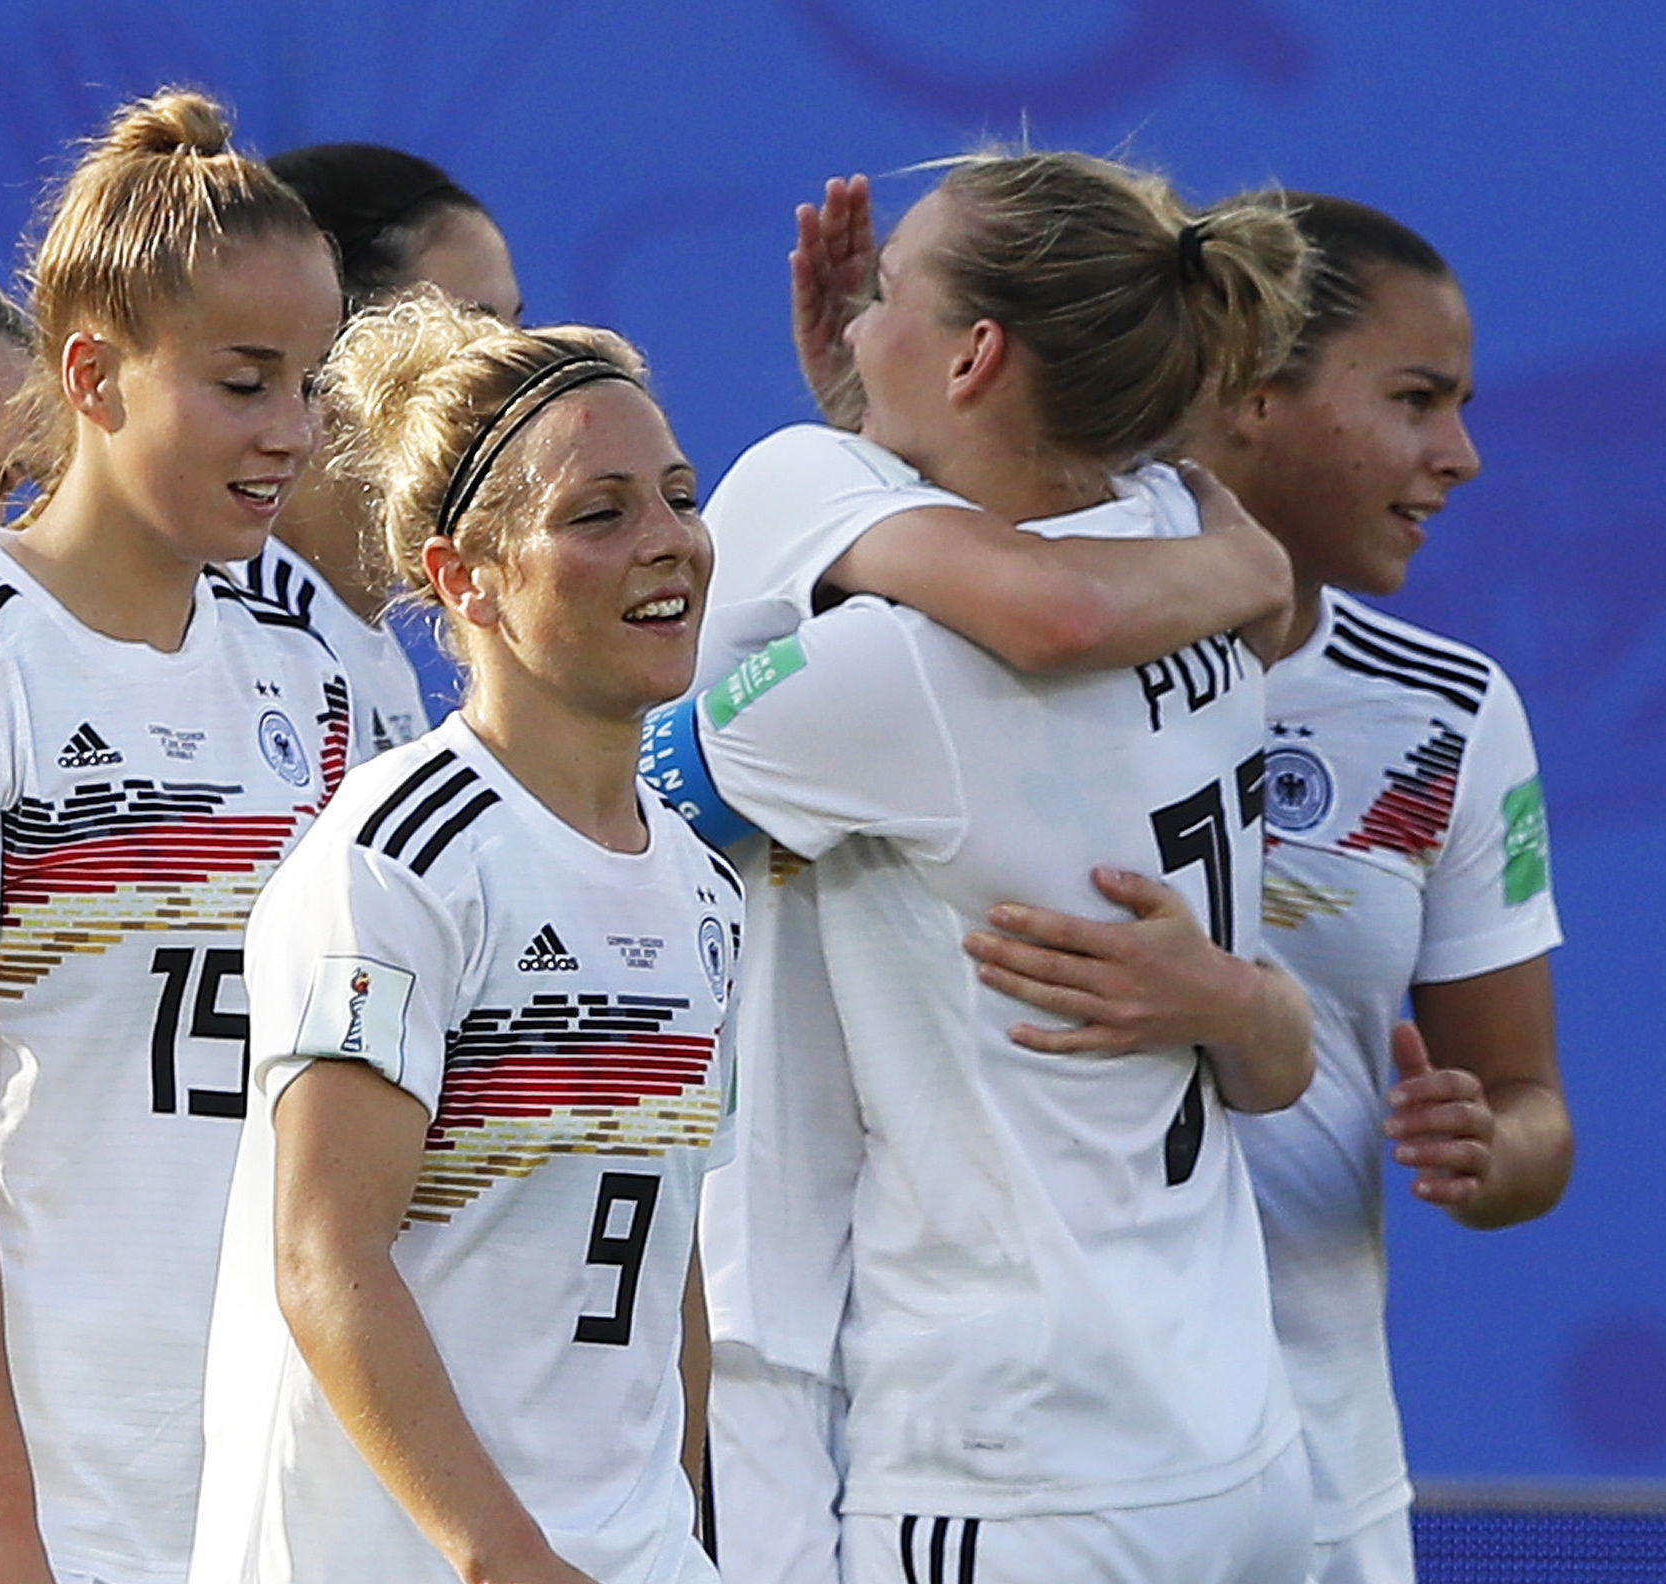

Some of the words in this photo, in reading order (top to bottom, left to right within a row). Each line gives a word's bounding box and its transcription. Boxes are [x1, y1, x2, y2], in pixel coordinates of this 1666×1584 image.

[58, 749, 124, 768] adidas
[517, 955, 579, 972] adidas
[149, 947, 249, 1118] 15
[573, 1172, 661, 1346] 9
